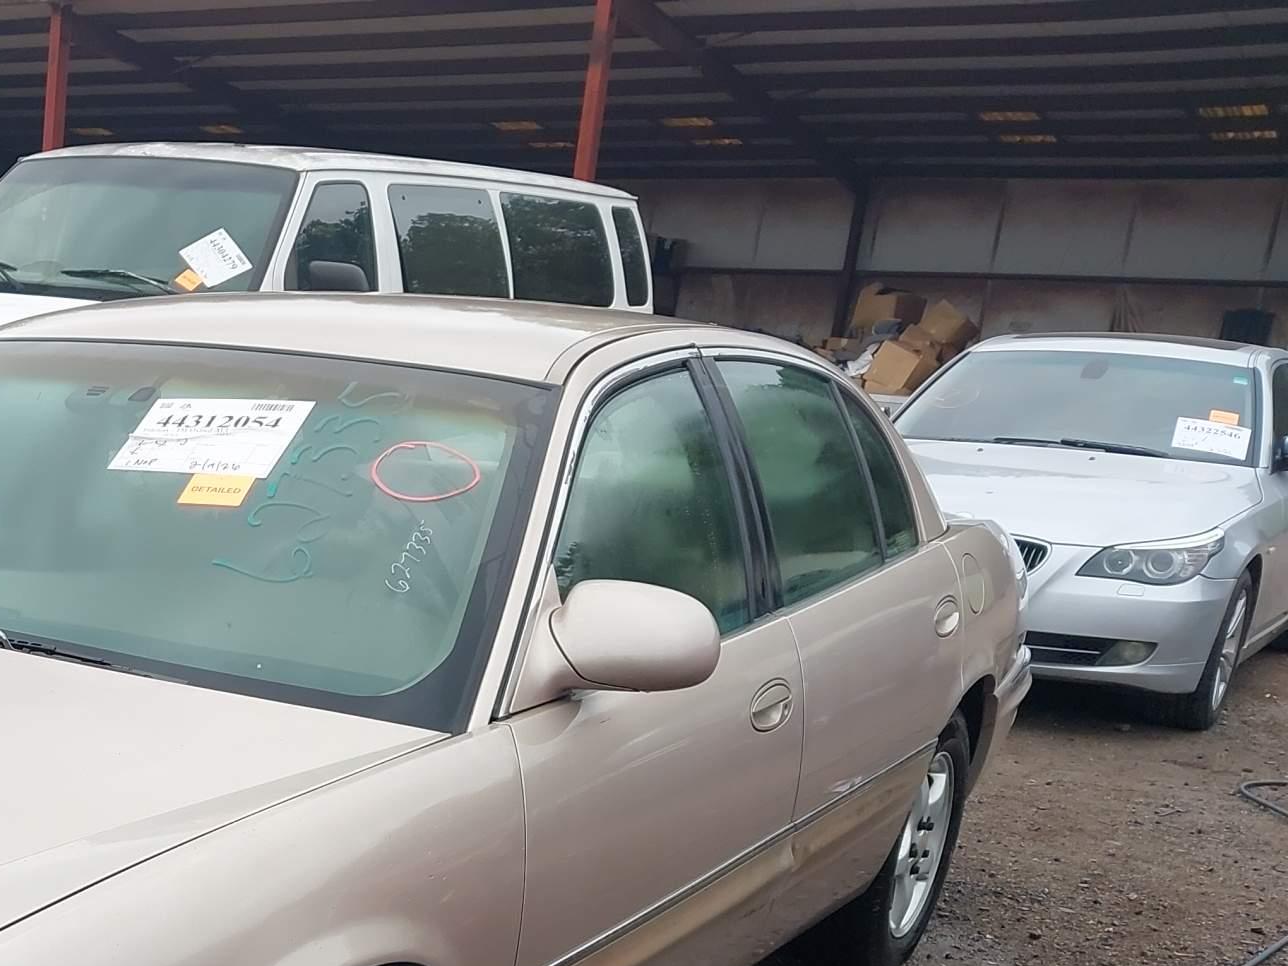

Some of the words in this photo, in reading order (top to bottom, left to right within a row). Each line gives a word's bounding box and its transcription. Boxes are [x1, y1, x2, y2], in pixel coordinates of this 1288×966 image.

[156, 414, 283, 428] 44312054
[191, 486, 242, 494] DETAILED
[384, 519, 433, 593] 627335
